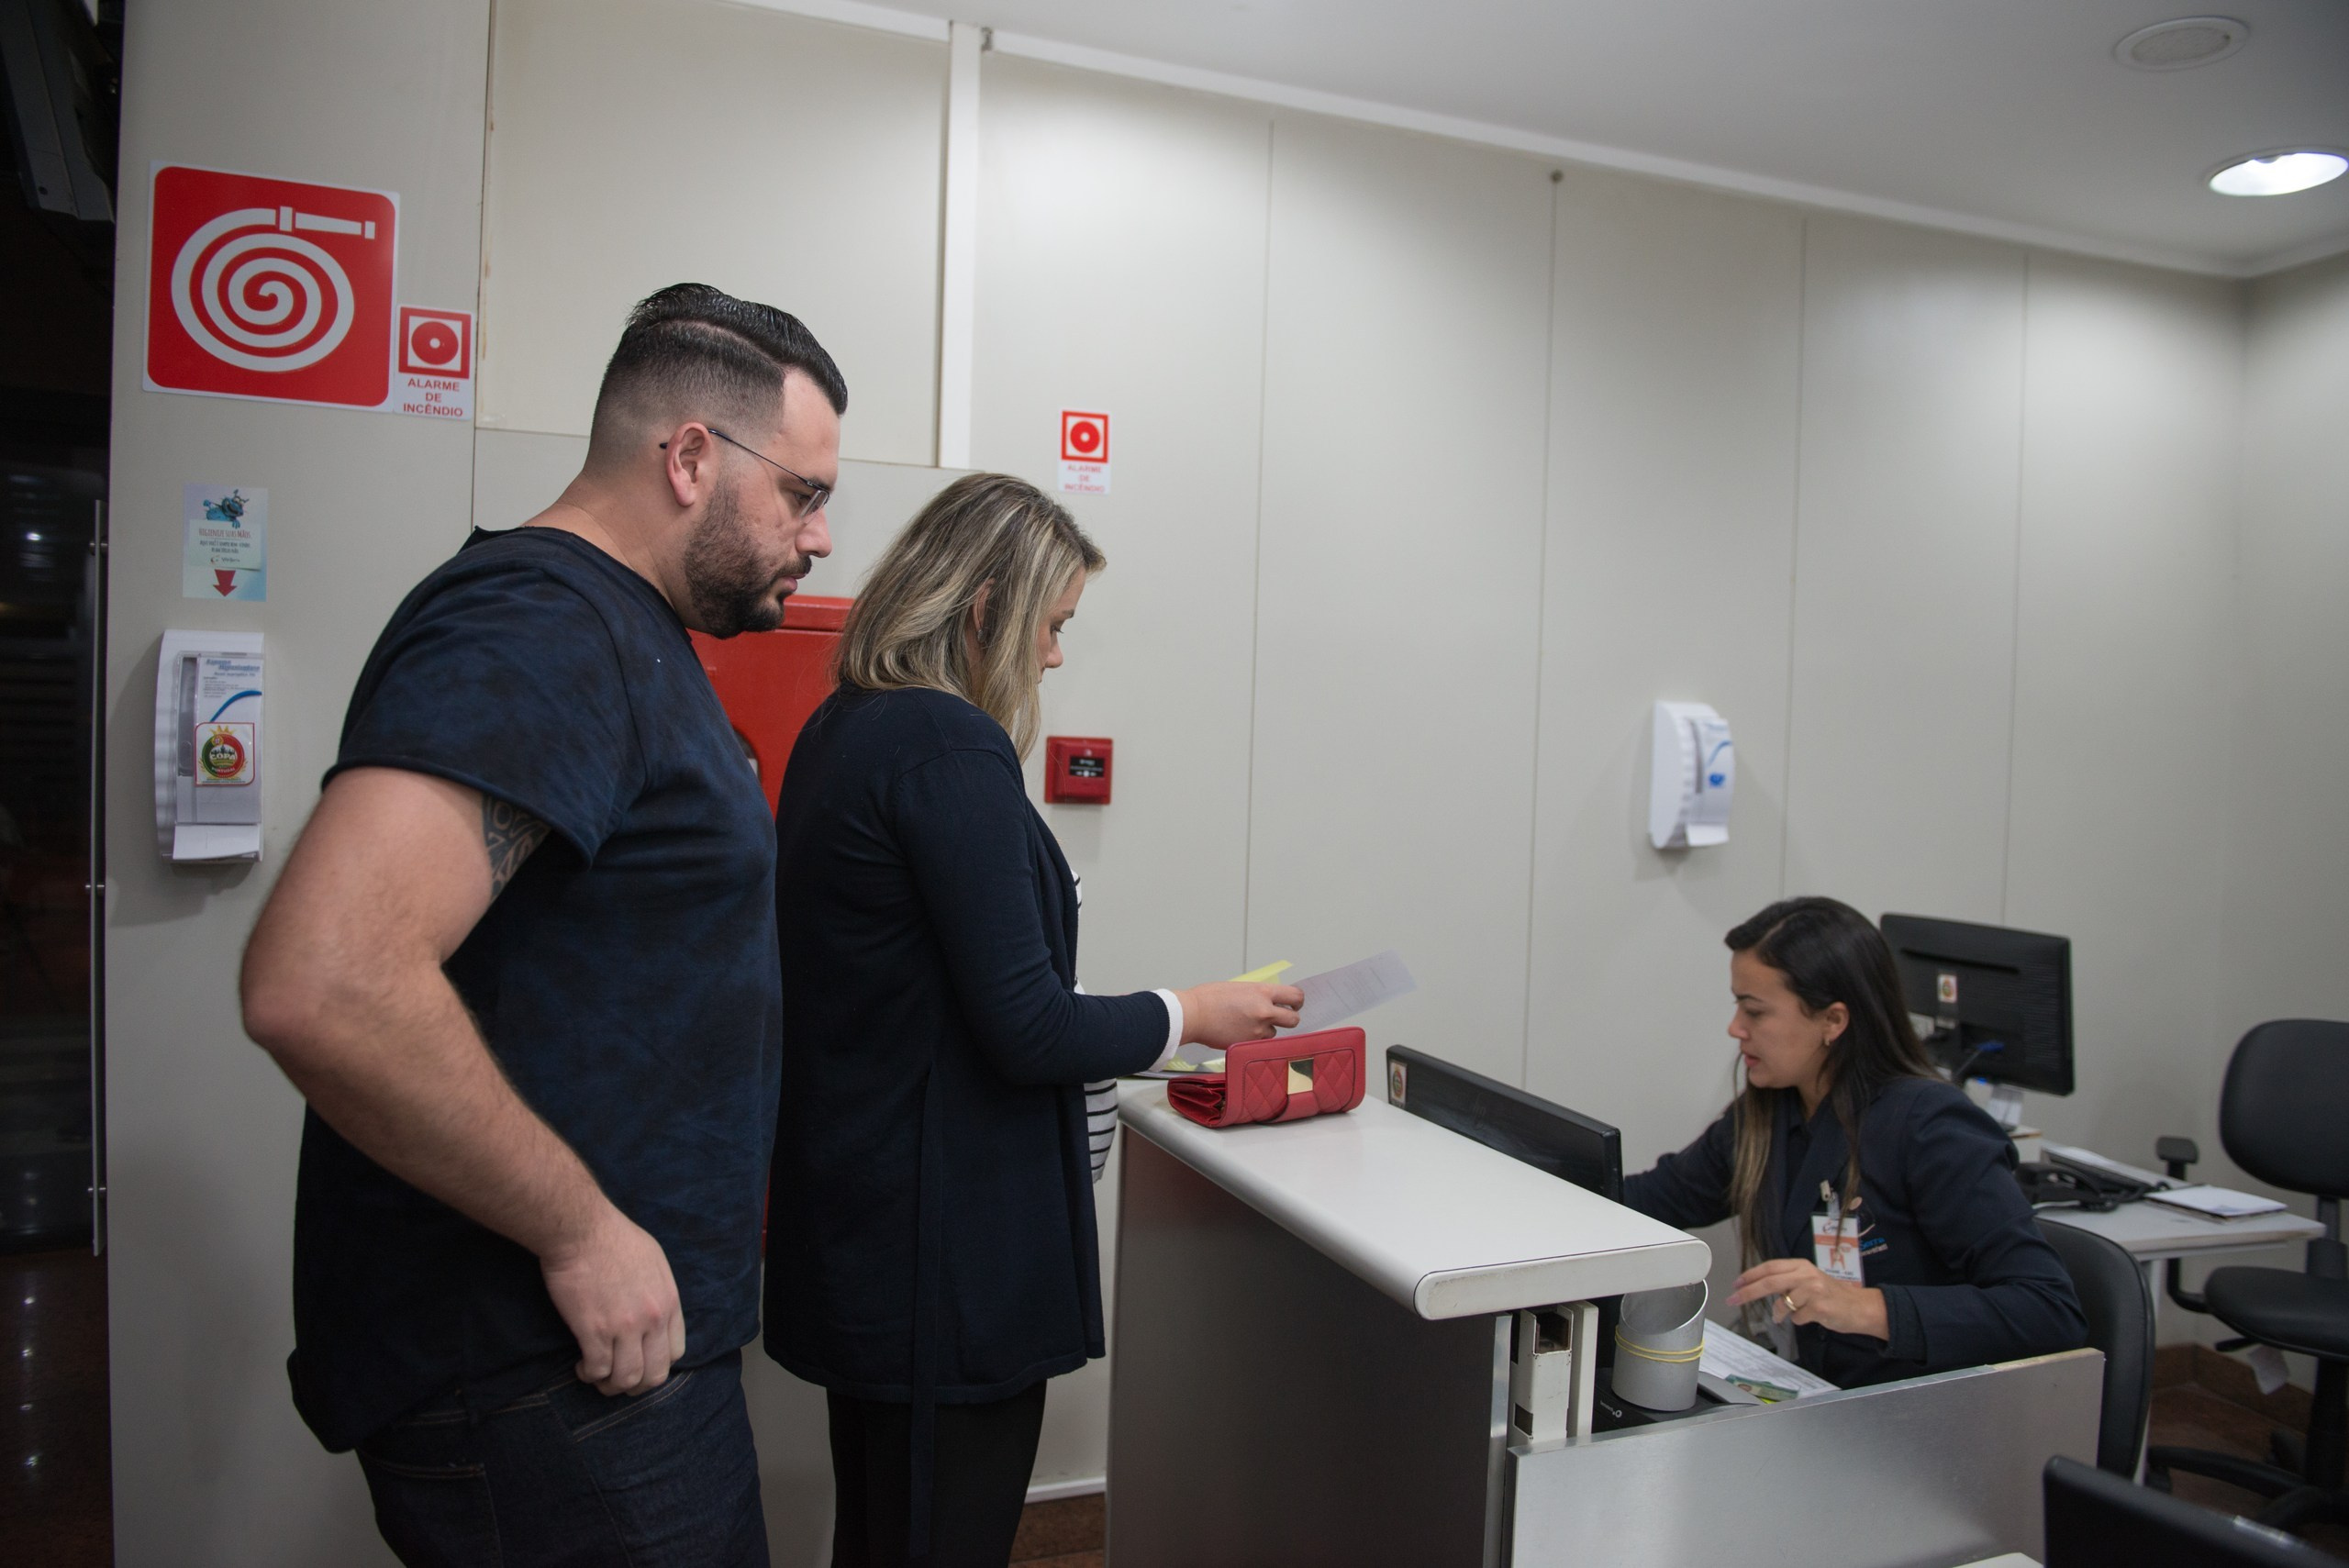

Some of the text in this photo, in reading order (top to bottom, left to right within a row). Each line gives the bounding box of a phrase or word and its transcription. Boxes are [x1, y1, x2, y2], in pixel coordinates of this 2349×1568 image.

[407, 377, 461, 392] ALARME
[425, 392, 442, 404] DE
[403, 403, 463, 417] INCÊNDIO
[1067, 464, 1102, 473] ALARME
